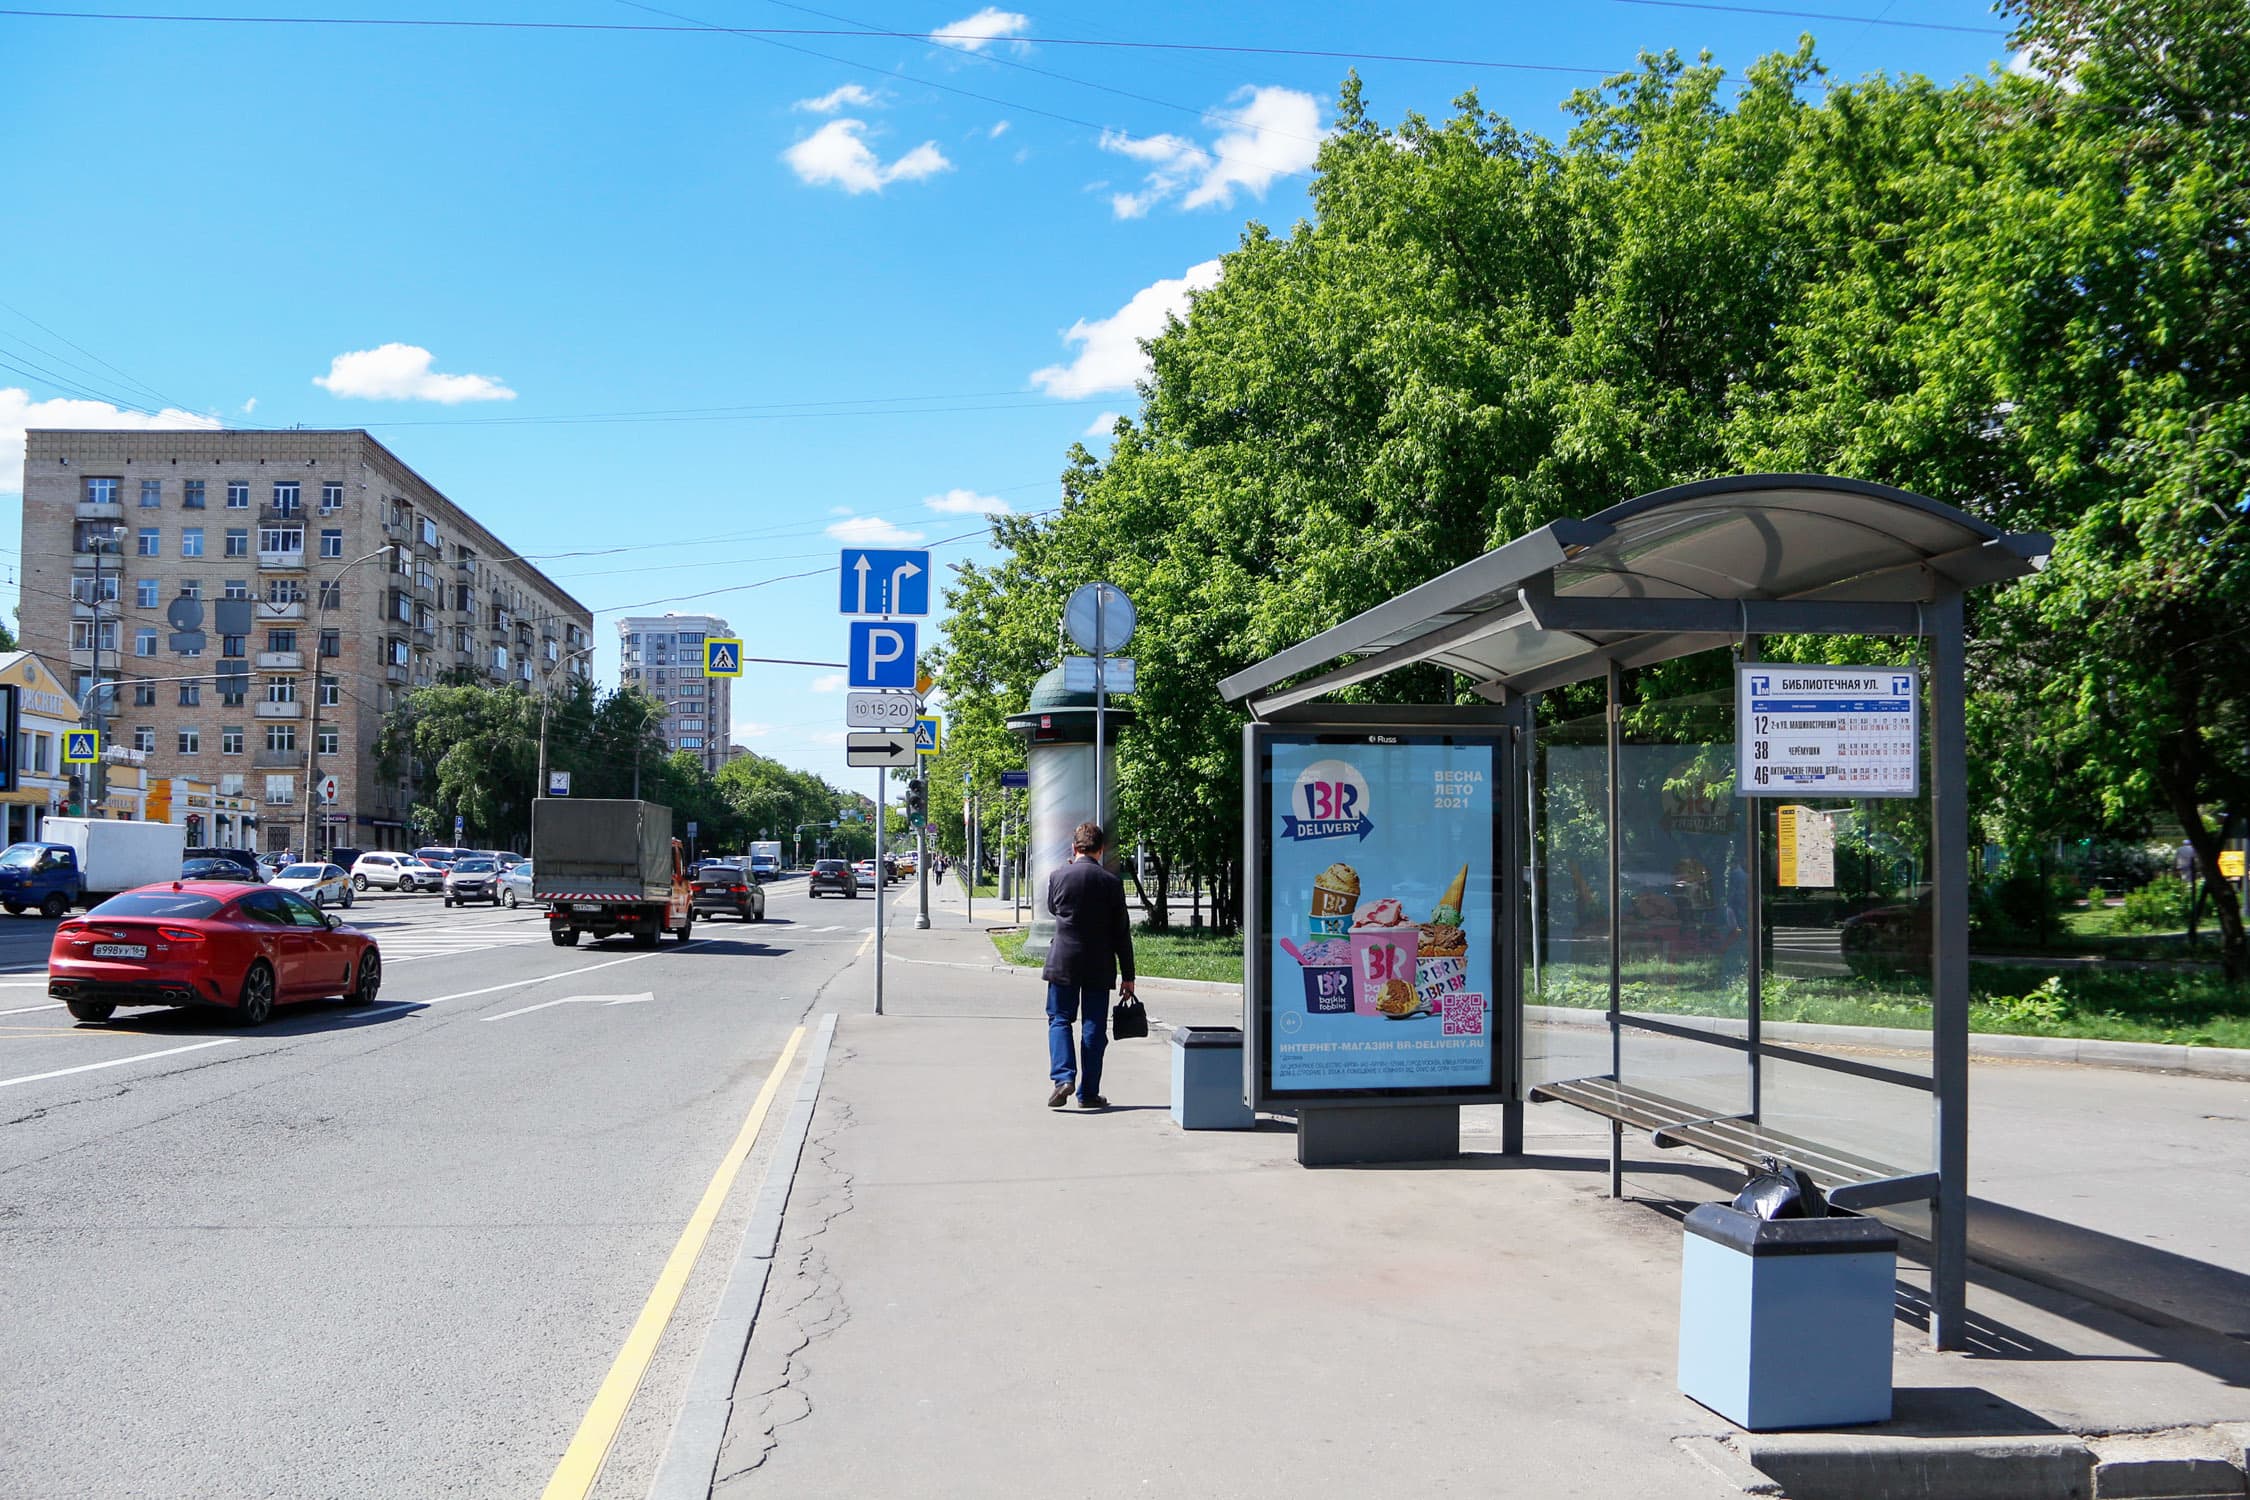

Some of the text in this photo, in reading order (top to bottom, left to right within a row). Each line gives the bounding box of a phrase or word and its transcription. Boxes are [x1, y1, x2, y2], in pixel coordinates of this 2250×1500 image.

[867, 628, 905, 681] P
[1782, 679, 1879, 690] БИБЛИОТЕЧНАЯ УЛ.
[855, 704, 909, 717] 10 15 20
[1754, 715, 1769, 735] 12
[1377, 735, 1397, 743] Russ
[1754, 740, 1769, 760] 38
[1434, 770, 1483, 782] ВЕСНА
[1754, 765, 1769, 785] 46
[1434, 783, 1474, 796] ЛЕТО
[1304, 781, 1359, 820] BR
[1434, 797, 1469, 809] 2021
[1361, 944, 1408, 980] BR
[1280, 1039, 1485, 1053] ИНТЕРНЕТ-МАГАЗИН BR-DELIVERY.RU
